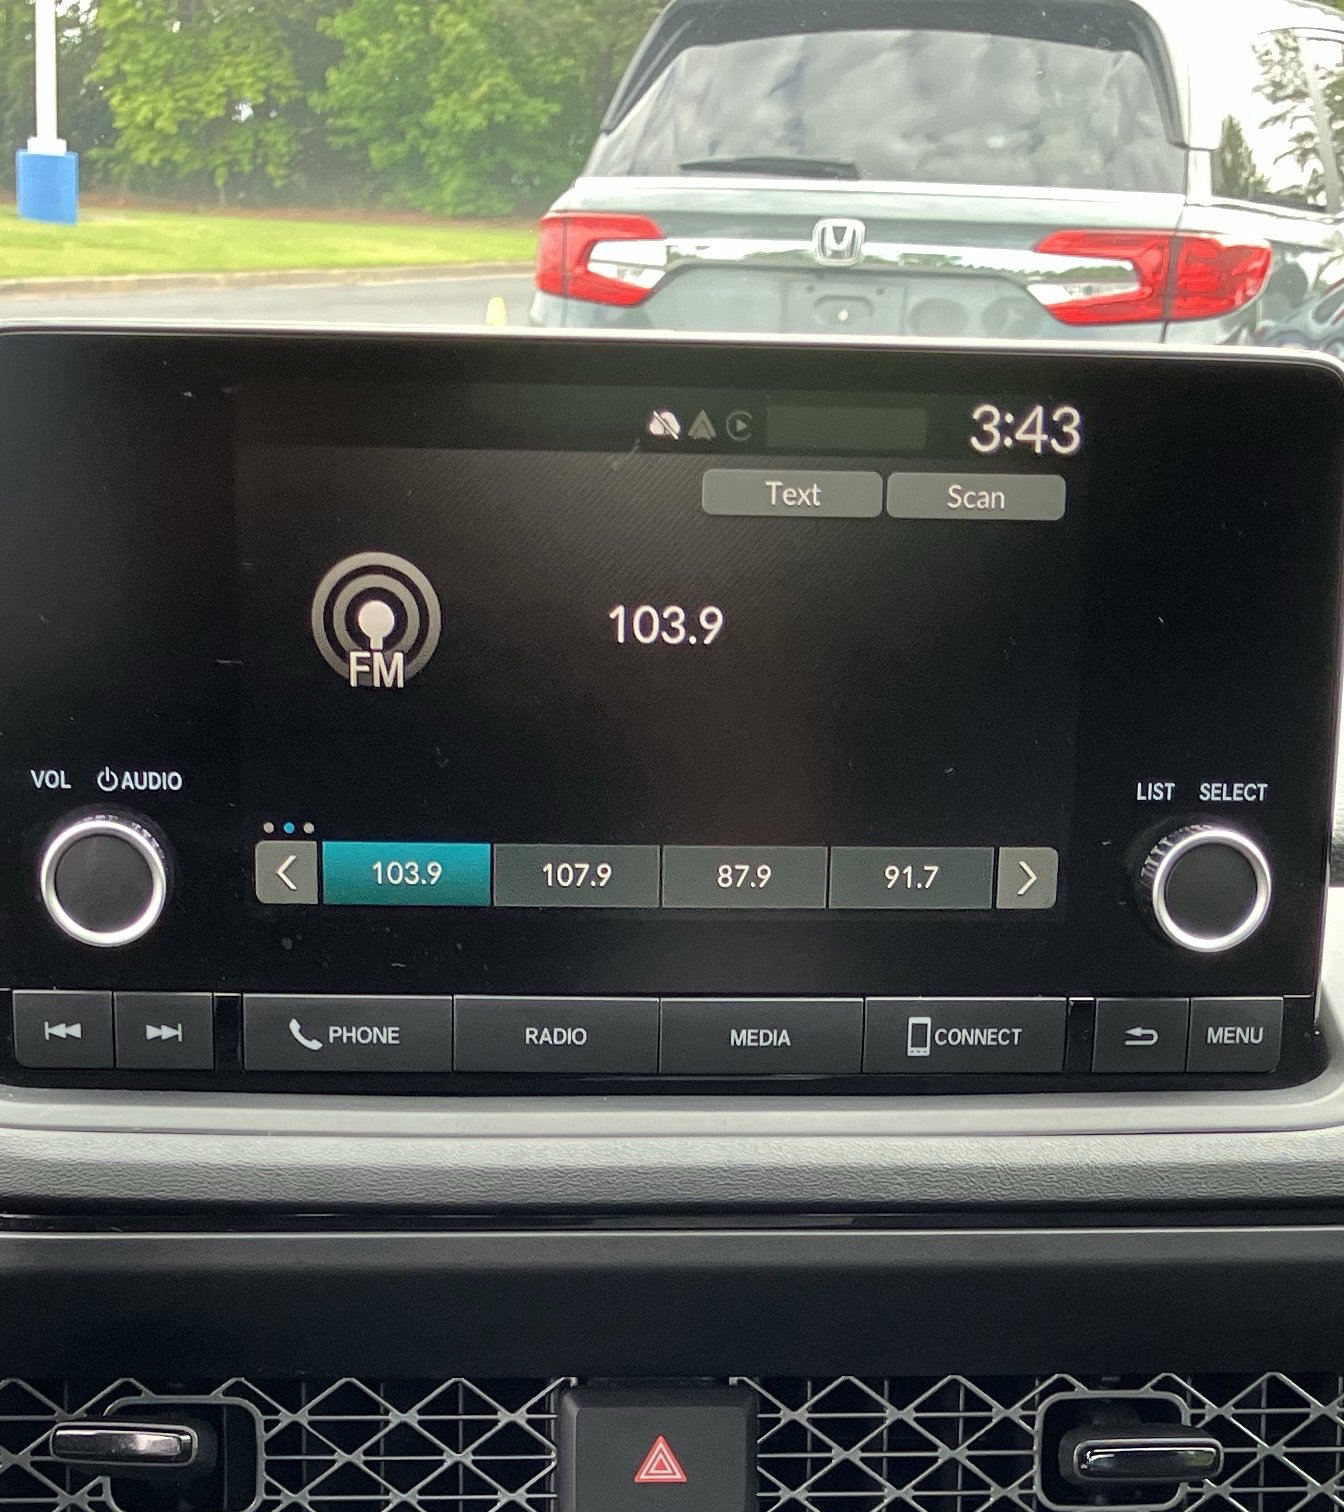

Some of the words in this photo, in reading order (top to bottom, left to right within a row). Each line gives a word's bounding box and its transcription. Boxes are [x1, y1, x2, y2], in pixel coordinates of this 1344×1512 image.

[970, 403, 1083, 456] 3:43
[765, 480, 821, 507] Text
[947, 484, 1005, 511] Scan
[609, 604, 725, 646] 103.9
[348, 650, 405, 688] FM
[30, 769, 72, 789] VOL
[121, 771, 183, 791] AUDIO
[1136, 782, 1176, 801] LIST
[1199, 782, 1269, 802] SELECT
[372, 861, 444, 886] 103.9
[541, 863, 613, 888] 107.9
[717, 864, 773, 889] 87.9
[883, 865, 939, 889] 91.7
[329, 1026, 400, 1046] PHONE
[525, 1027, 588, 1046] RADIO
[730, 1028, 792, 1047] MEDIA
[934, 1028, 1023, 1046] CONNECT
[1206, 1026, 1265, 1044] MENU
